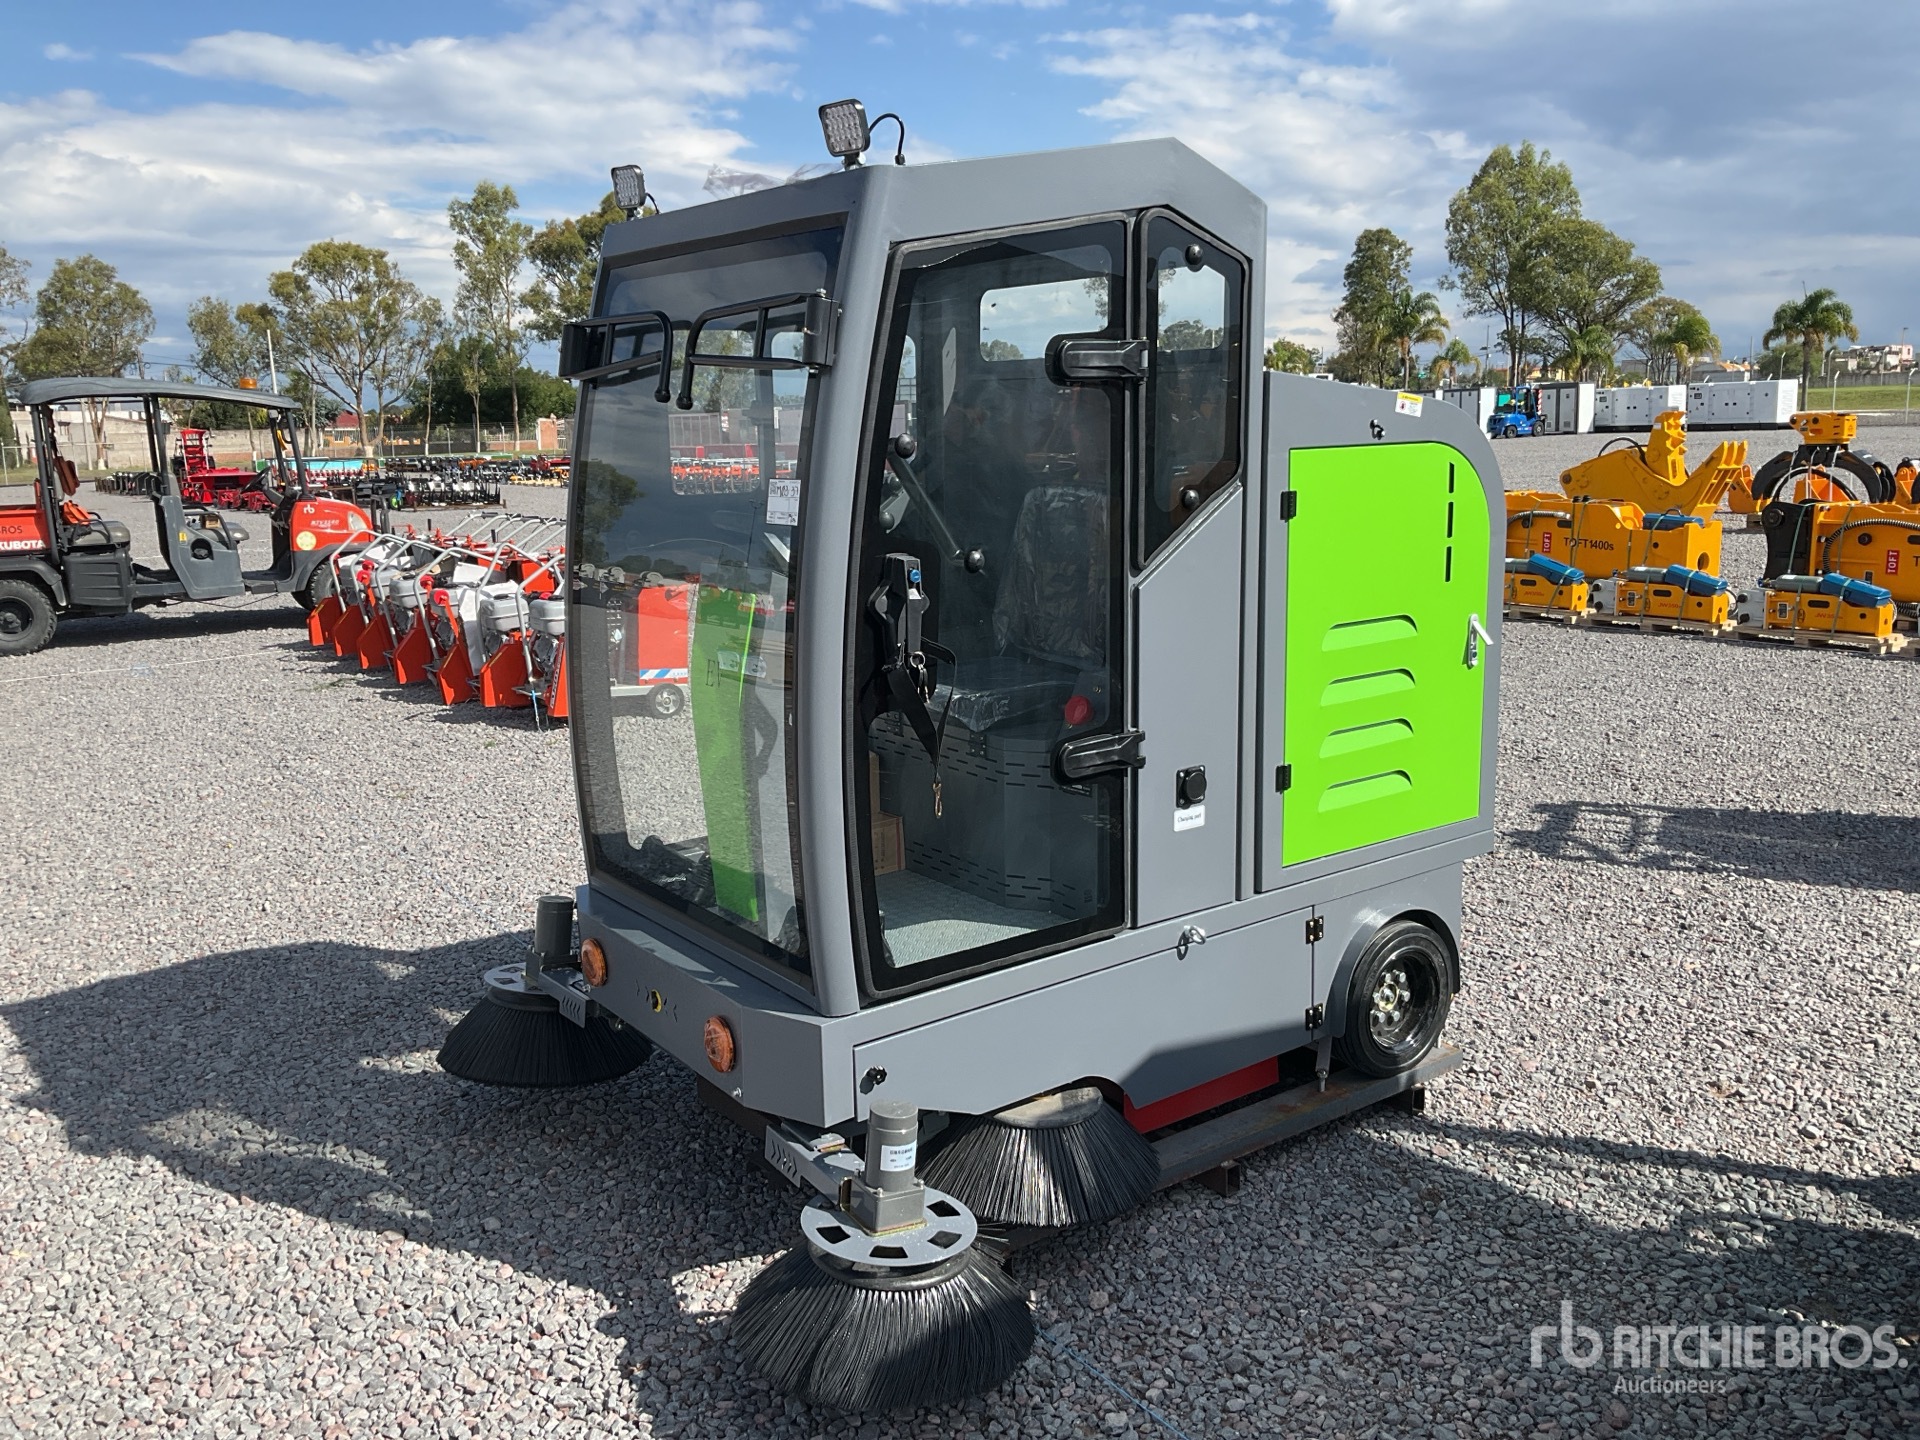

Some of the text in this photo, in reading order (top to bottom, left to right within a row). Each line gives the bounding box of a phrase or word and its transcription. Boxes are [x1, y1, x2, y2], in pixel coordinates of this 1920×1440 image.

[0, 525, 23, 535] ROS
[0, 539, 46, 550] KUBOTA
[1543, 533, 1551, 552] TOFT
[1563, 536, 1614, 551] TOFT1400s
[1887, 550, 1898, 573] TOFT
